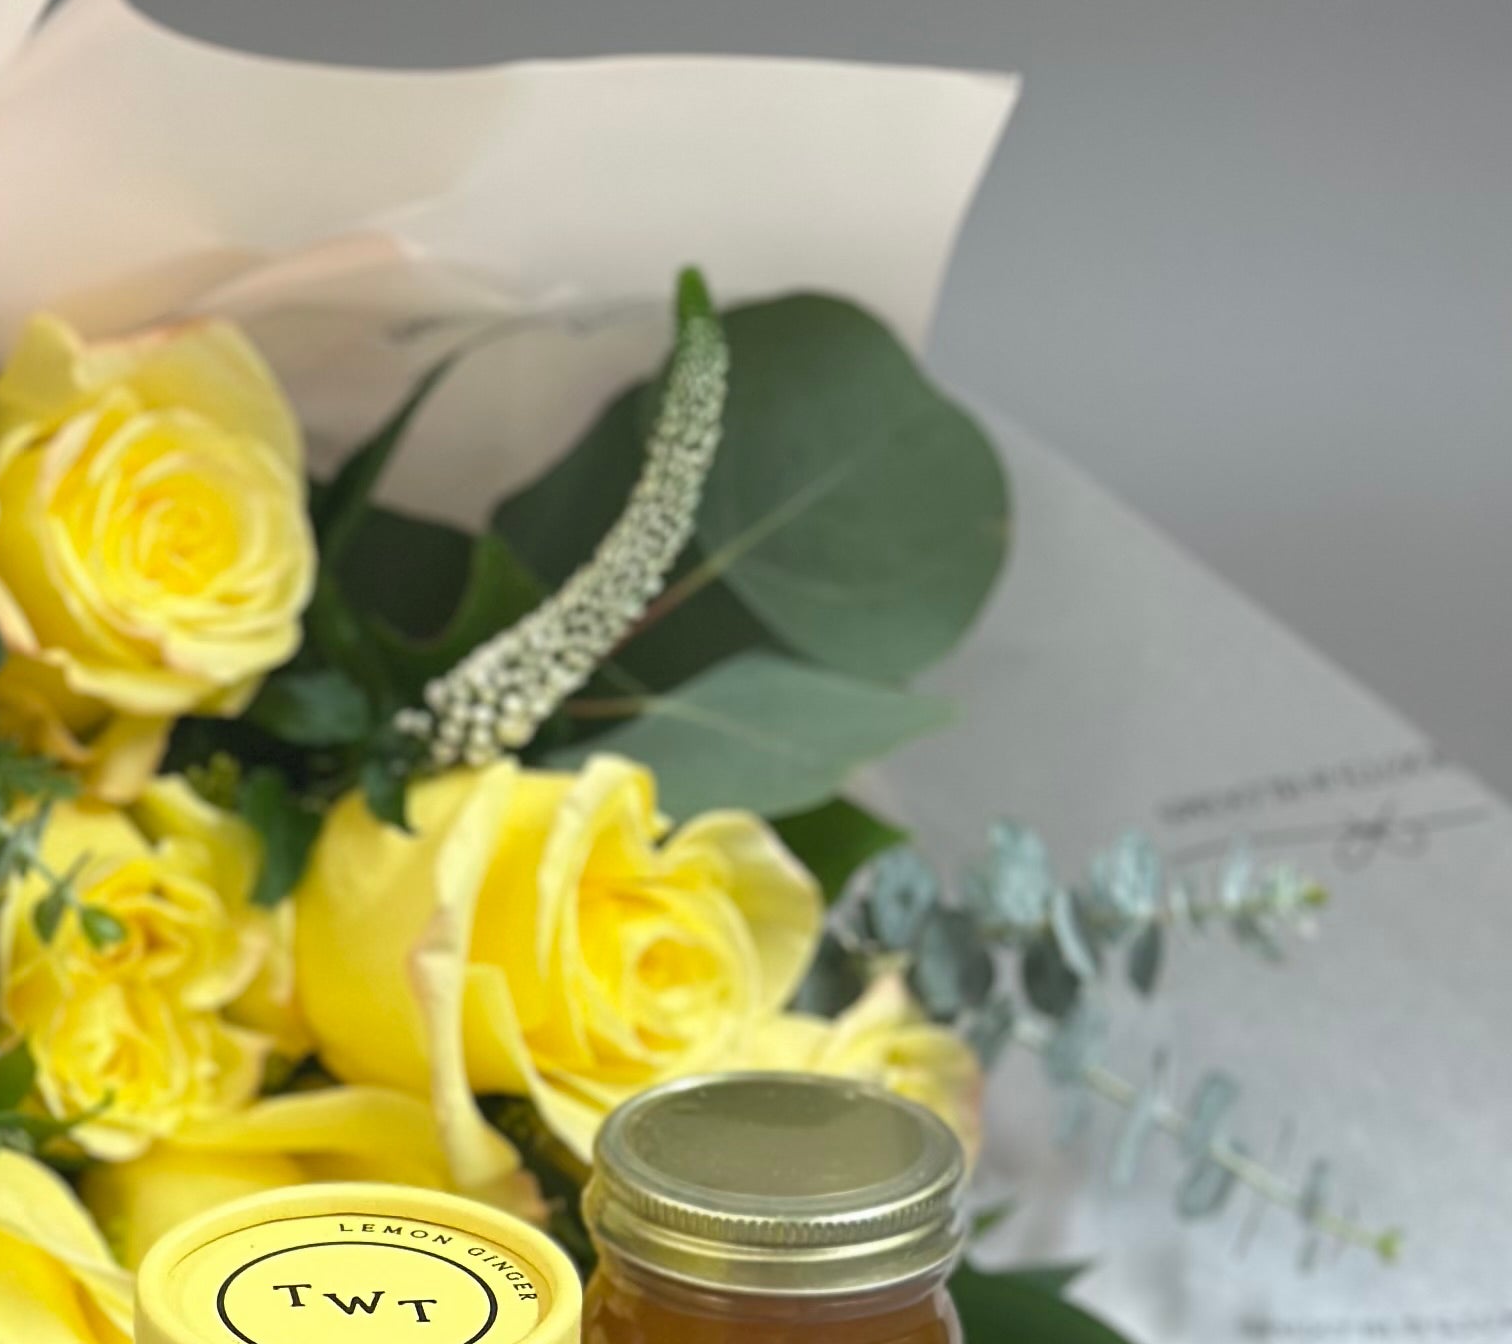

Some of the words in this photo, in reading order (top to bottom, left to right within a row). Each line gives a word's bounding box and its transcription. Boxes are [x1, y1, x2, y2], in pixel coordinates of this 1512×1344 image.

[338, 1223, 454, 1246] LEMON
[467, 1246, 539, 1302] GINGER
[272, 1283, 438, 1323] TWT
